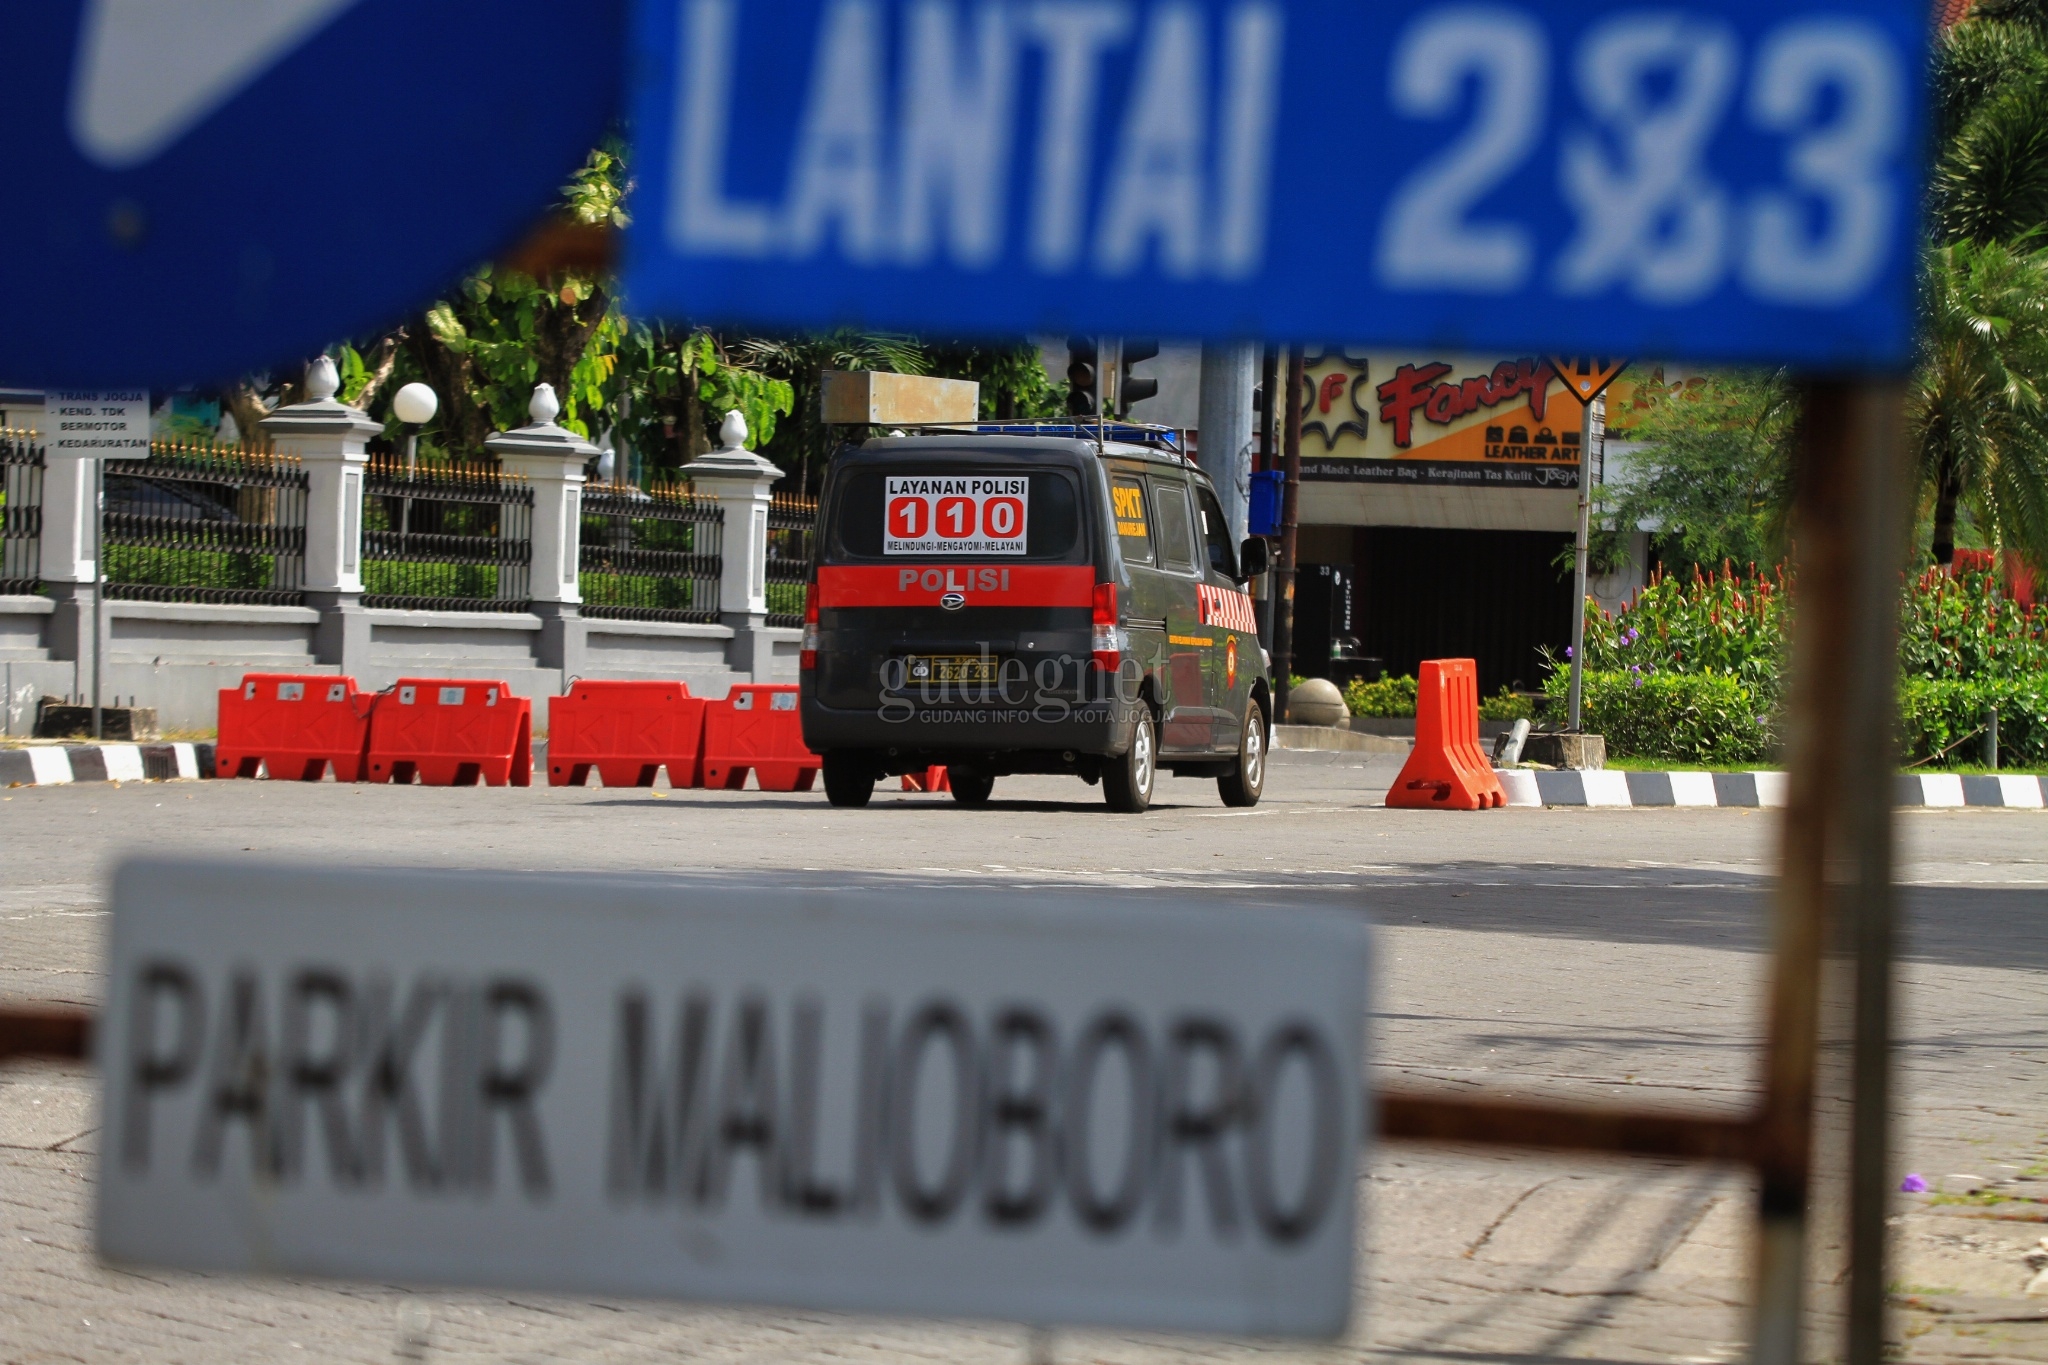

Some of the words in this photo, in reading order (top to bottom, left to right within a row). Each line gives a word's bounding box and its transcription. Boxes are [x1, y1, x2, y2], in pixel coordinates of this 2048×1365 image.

[662, 0, 1288, 280] LANTAI
[60, 392, 98, 401] TRANS
[103, 392, 143, 401] JOGJA
[59, 407, 96, 416] KEND.
[101, 408, 126, 416] TDK
[60, 422, 127, 431] BERMOTOR
[57, 439, 148, 448] KEDARURATAN
[1484, 444, 1548, 460] LEATHER
[1551, 448, 1581, 461] ART
[1298, 464, 1318, 474] and
[1321, 464, 1350, 475] Made
[1353, 465, 1394, 477] Leather
[1397, 466, 1418, 480] Bag
[1427, 467, 1482, 480] Kerajinan
[1484, 469, 1502, 481] Tas
[889, 480, 967, 495] LAYANAN
[971, 480, 1025, 495] POLISI
[1112, 486, 1143, 519] SPKT
[899, 501, 1015, 534] 110
[898, 568, 1010, 592] POLISI
[122, 950, 556, 1206] PARKIR
